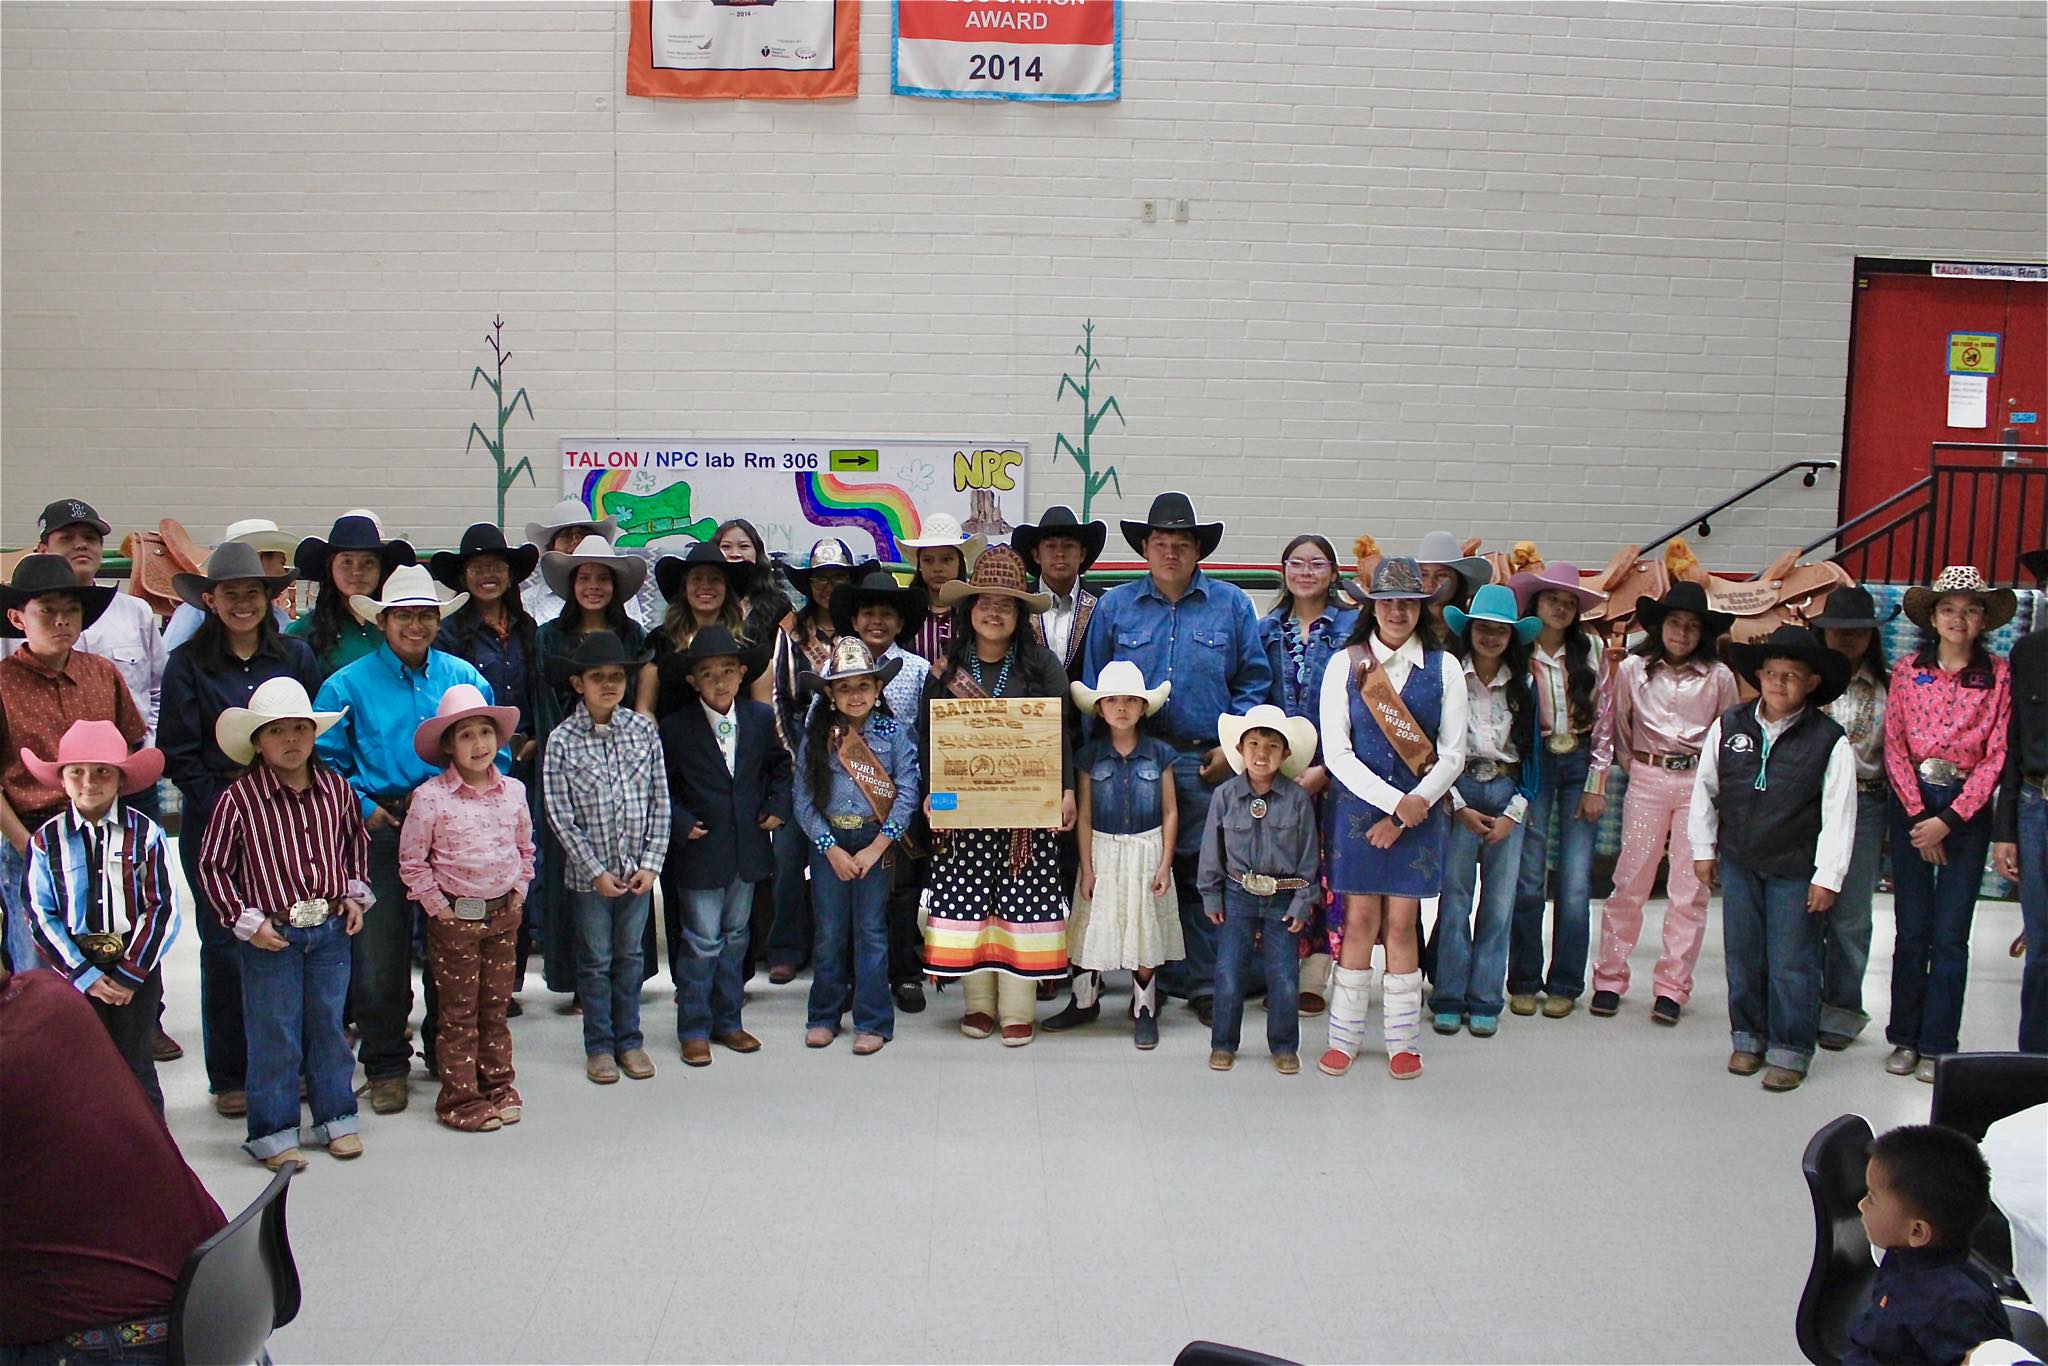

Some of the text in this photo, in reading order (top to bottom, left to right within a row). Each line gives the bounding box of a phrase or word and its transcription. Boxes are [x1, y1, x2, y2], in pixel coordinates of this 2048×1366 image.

[964, 10, 1048, 31] AWARD
[968, 54, 1044, 82] 2014
[1935, 265, 1968, 275] TALON
[2018, 268, 2038, 279] Rm
[565, 451, 818, 469] TALON / NPC lab Rm 306
[953, 449, 1023, 492] NPC
[931, 699, 1008, 719] BATTLE
[1376, 702, 1399, 717] Miss
[1385, 714, 1411, 731] WJRA
[1395, 728, 1420, 743] 2026
[850, 760, 875, 776] WJRA
[855, 772, 890, 789] Princess
[872, 785, 894, 799] 2026
